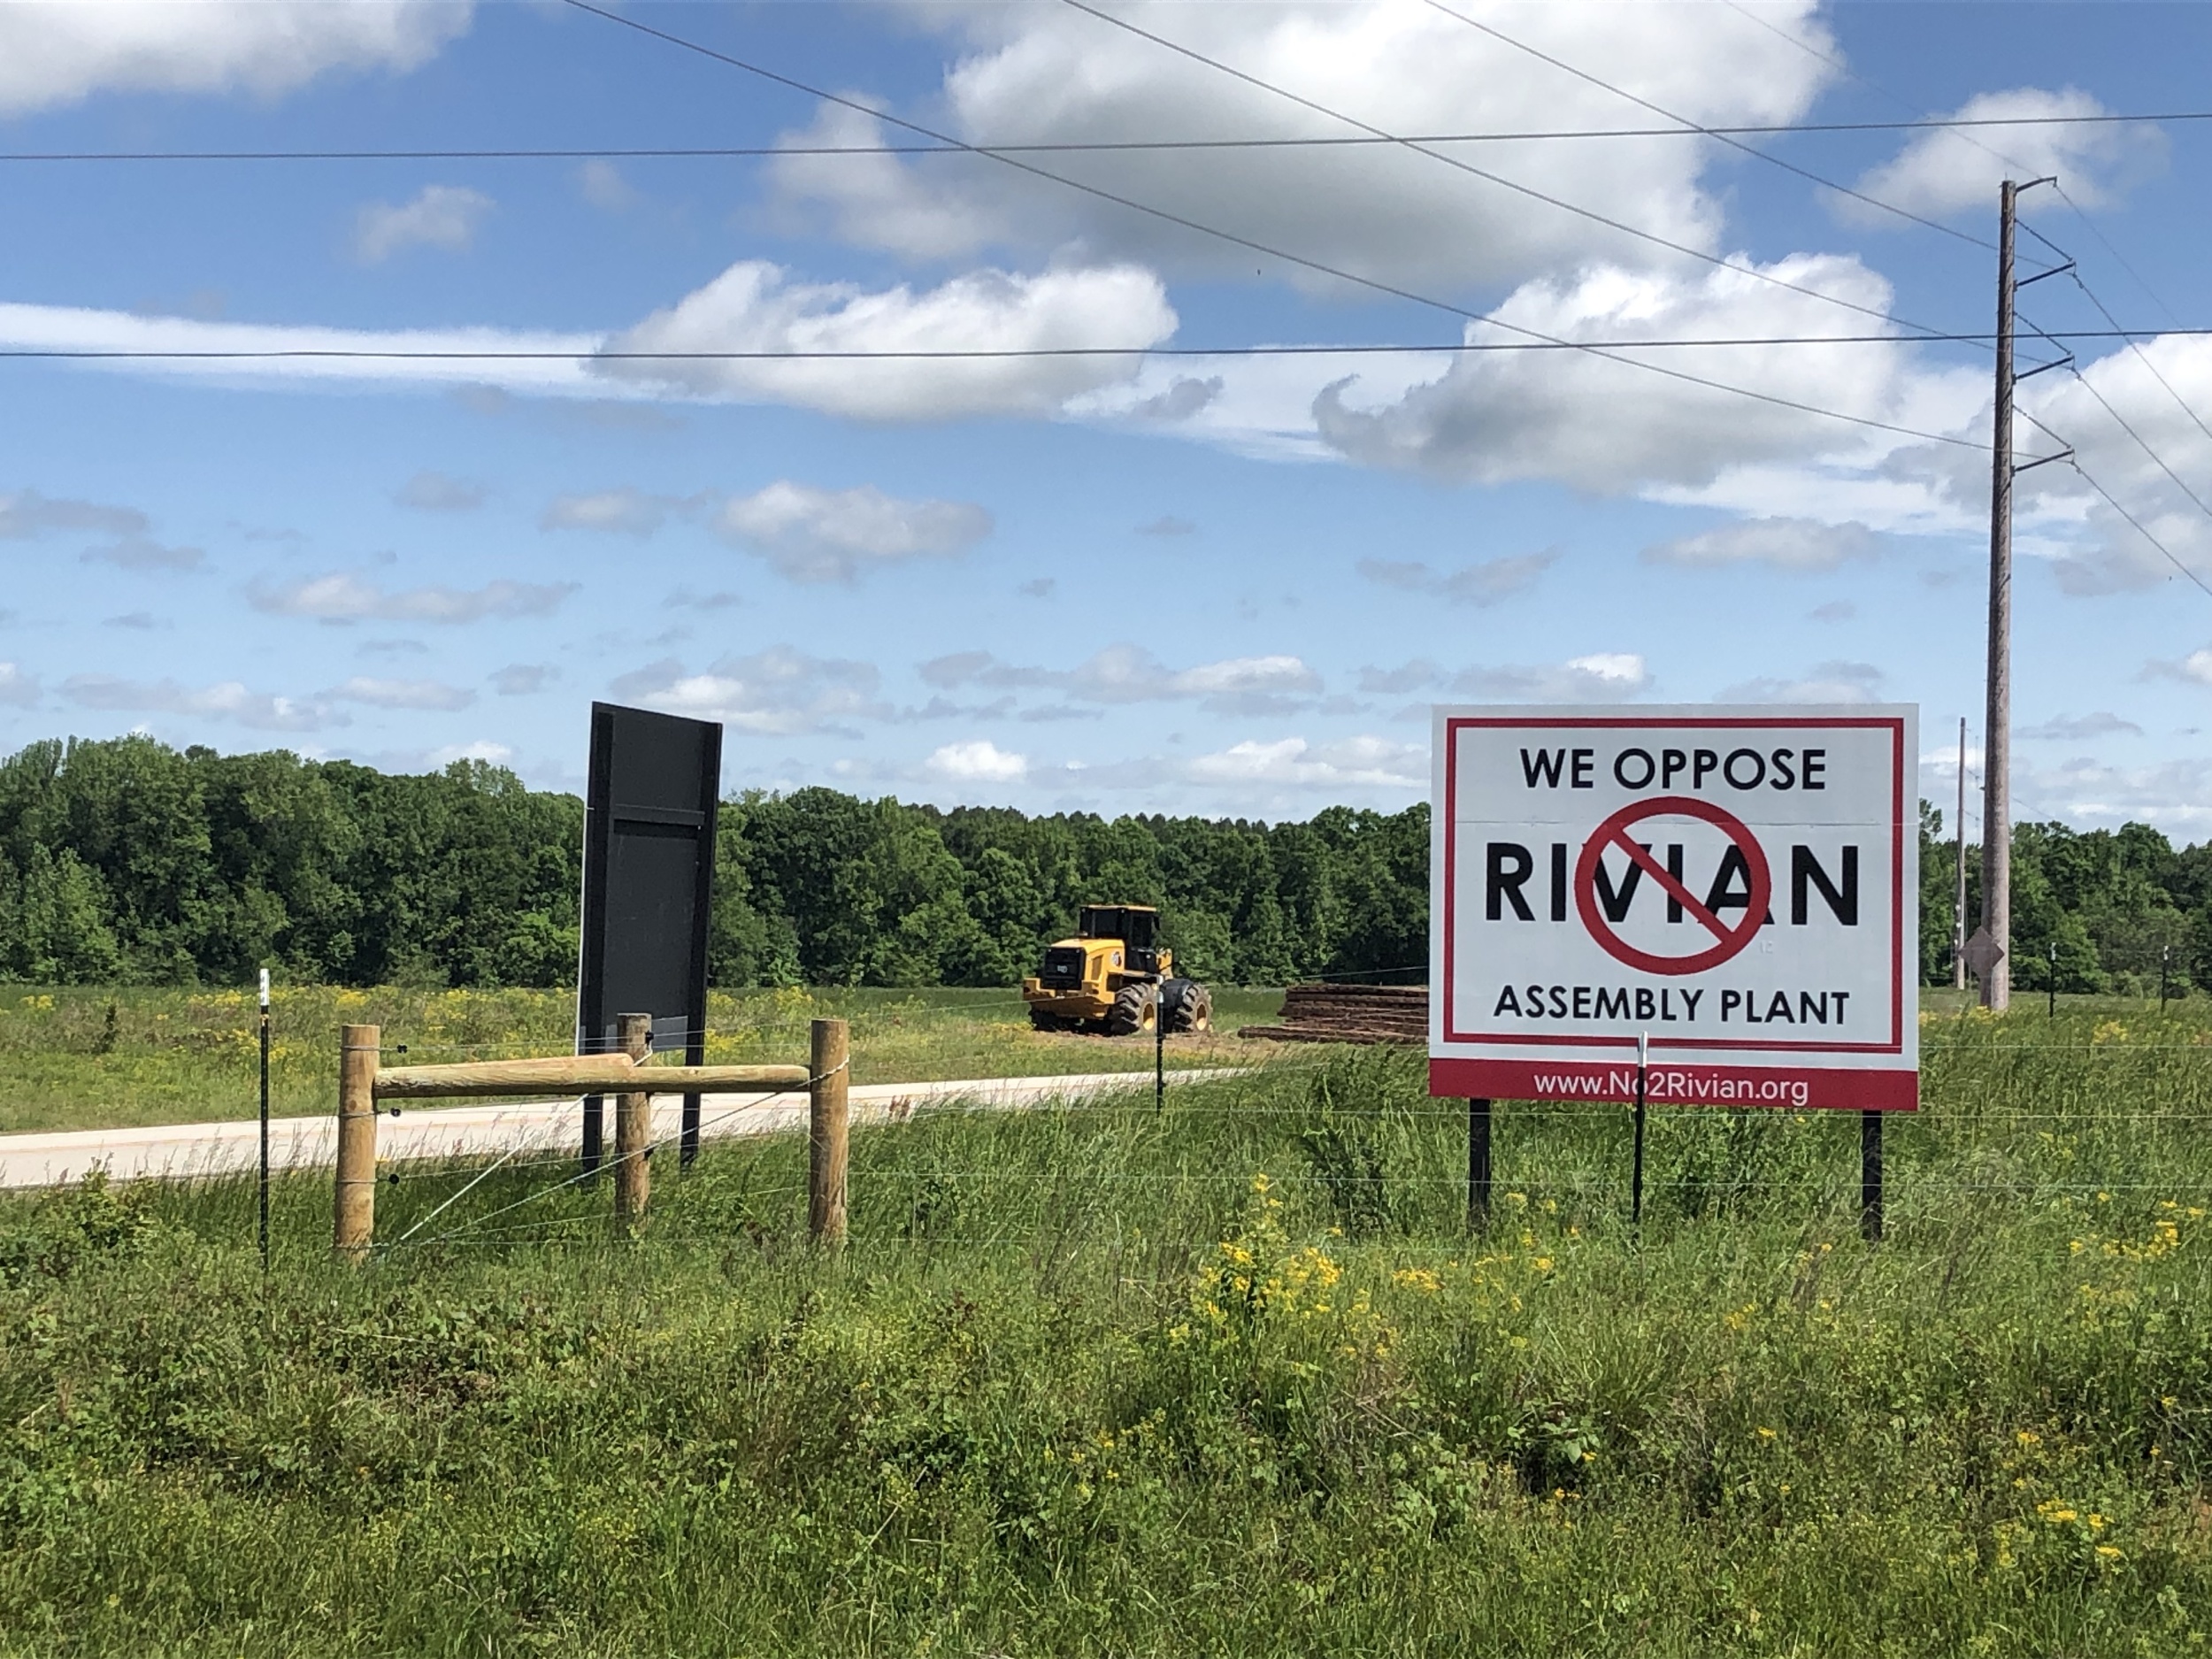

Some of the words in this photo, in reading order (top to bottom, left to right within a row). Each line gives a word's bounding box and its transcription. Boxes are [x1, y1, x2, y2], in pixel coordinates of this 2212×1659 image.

[1519, 749, 1594, 788] WE
[1613, 748, 1826, 790] OPPOSE
[1485, 842, 1859, 926] RIVIAN
[1494, 985, 1704, 1021] ASSEMBLY
[1721, 989, 1850, 1025] PLANT
[1533, 1070, 1809, 1106] www.No2Rivian.org
